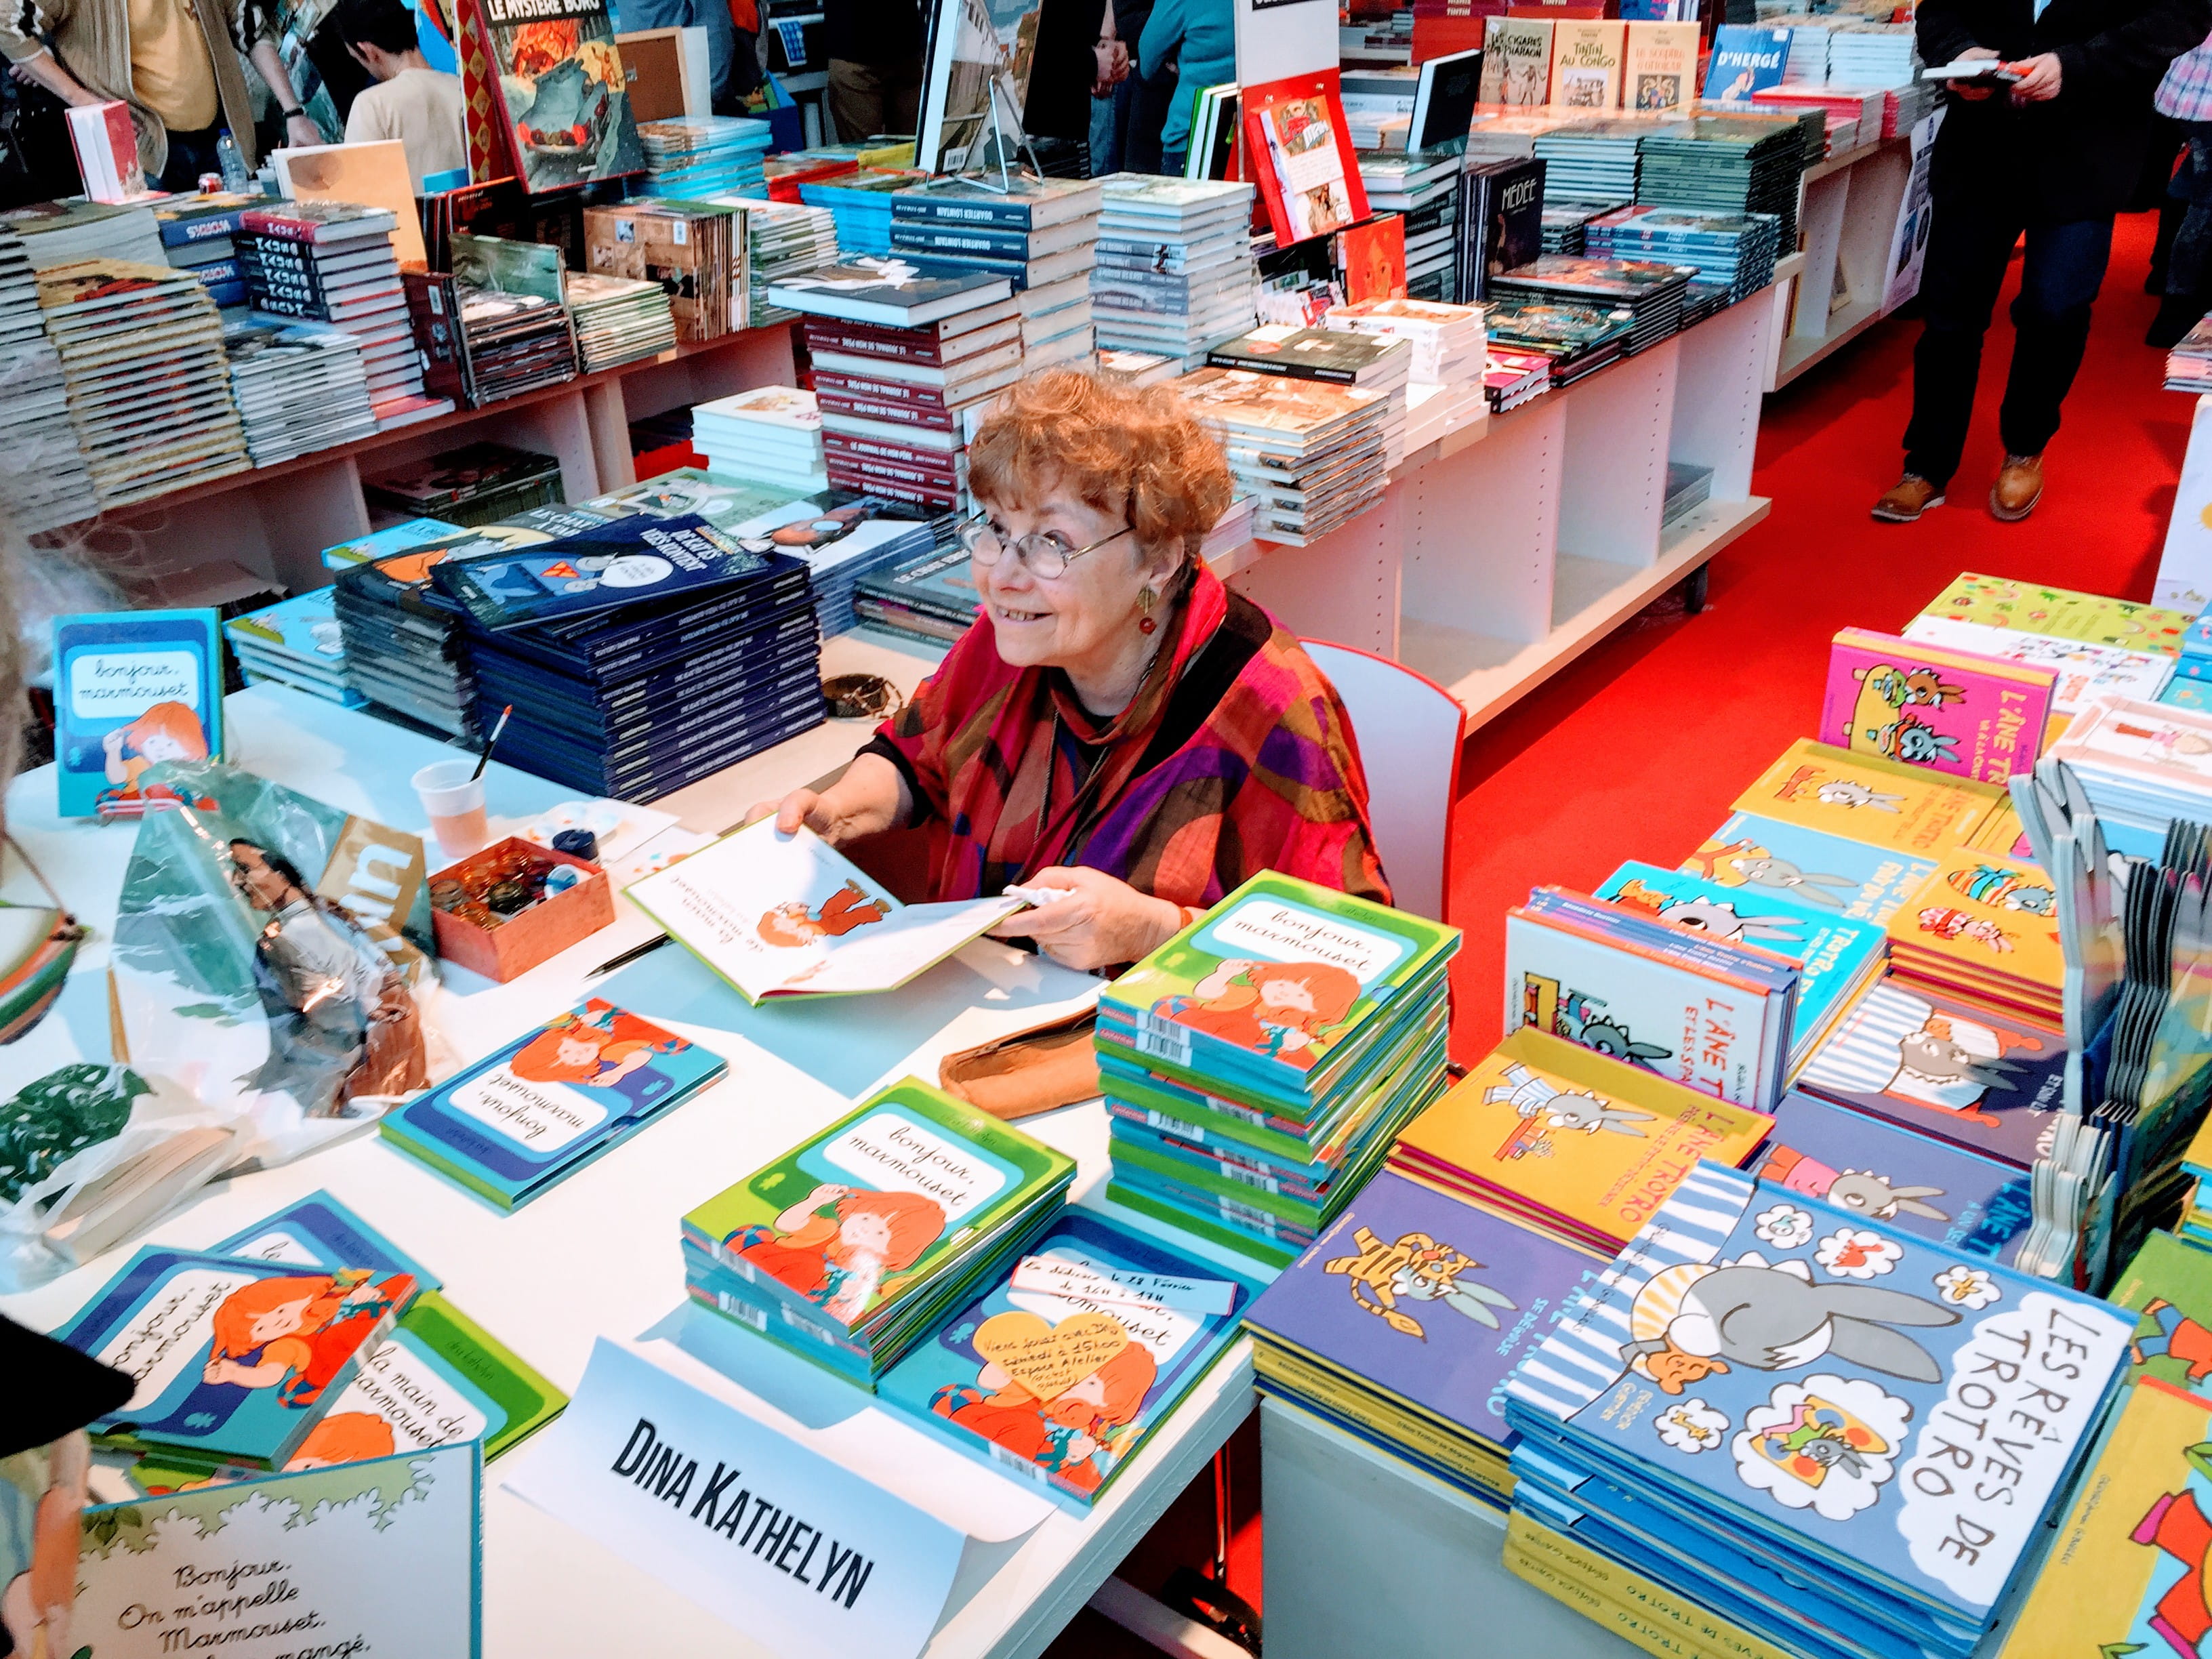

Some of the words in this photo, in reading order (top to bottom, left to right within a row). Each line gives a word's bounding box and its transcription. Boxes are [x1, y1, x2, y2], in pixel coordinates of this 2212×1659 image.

[487, 0, 506, 21] LE
[1508, 33, 1543, 47] CIGARES
[1559, 54, 1575, 66] AU
[1580, 56, 1616, 67] CONGO
[1574, 43, 1603, 56] TINTIN
[1717, 51, 1781, 68] D'HERGÉ
[936, 207, 963, 220] LOINTAIN
[964, 209, 994, 222] QUARTIER
[935, 235, 961, 249] LOINTAIN
[962, 238, 991, 251] QUARTIER
[78, 681, 189, 699] marmouset
[94, 658, 180, 685] bonjour,
[1234, 919, 1371, 976] marmouset
[1268, 909, 1372, 954] bonjour,
[1702, 996, 1739, 1076] L'ÂNE
[478, 1090, 548, 1142] bonjour,
[489, 1069, 586, 1127] marmouset
[887, 1125, 976, 1185] bonjour,
[1683, 1110, 1736, 1160] L'ÂNE
[848, 1133, 968, 1206] marmouset
[1620, 1155, 1696, 1223] TROTRO
[1530, 1296, 1549, 1316] SE
[112, 1287, 197, 1371] onjour,
[1495, 1315, 1537, 1357] DÉGUISE
[2042, 1308, 2102, 1381] LES
[366, 1346, 398, 1374] la
[390, 1372, 438, 1416] main
[436, 1414, 468, 1440] de
[1911, 1327, 2032, 1498] TROTRO
[1973, 1380, 2070, 1507] RÊVES
[610, 1417, 699, 1510] DINA
[689, 1461, 875, 1610] KATHELYN
[1938, 1513, 1999, 1566] DE
[173, 1559, 293, 1591] Bonjour.
[117, 1602, 164, 1632] On
[172, 1580, 301, 1624] m'appelle
[1623, 1583, 1696, 1628] TROTRO
[158, 1612, 327, 1655] Marmouset.
[1613, 1610, 1687, 1656] TROTRO
